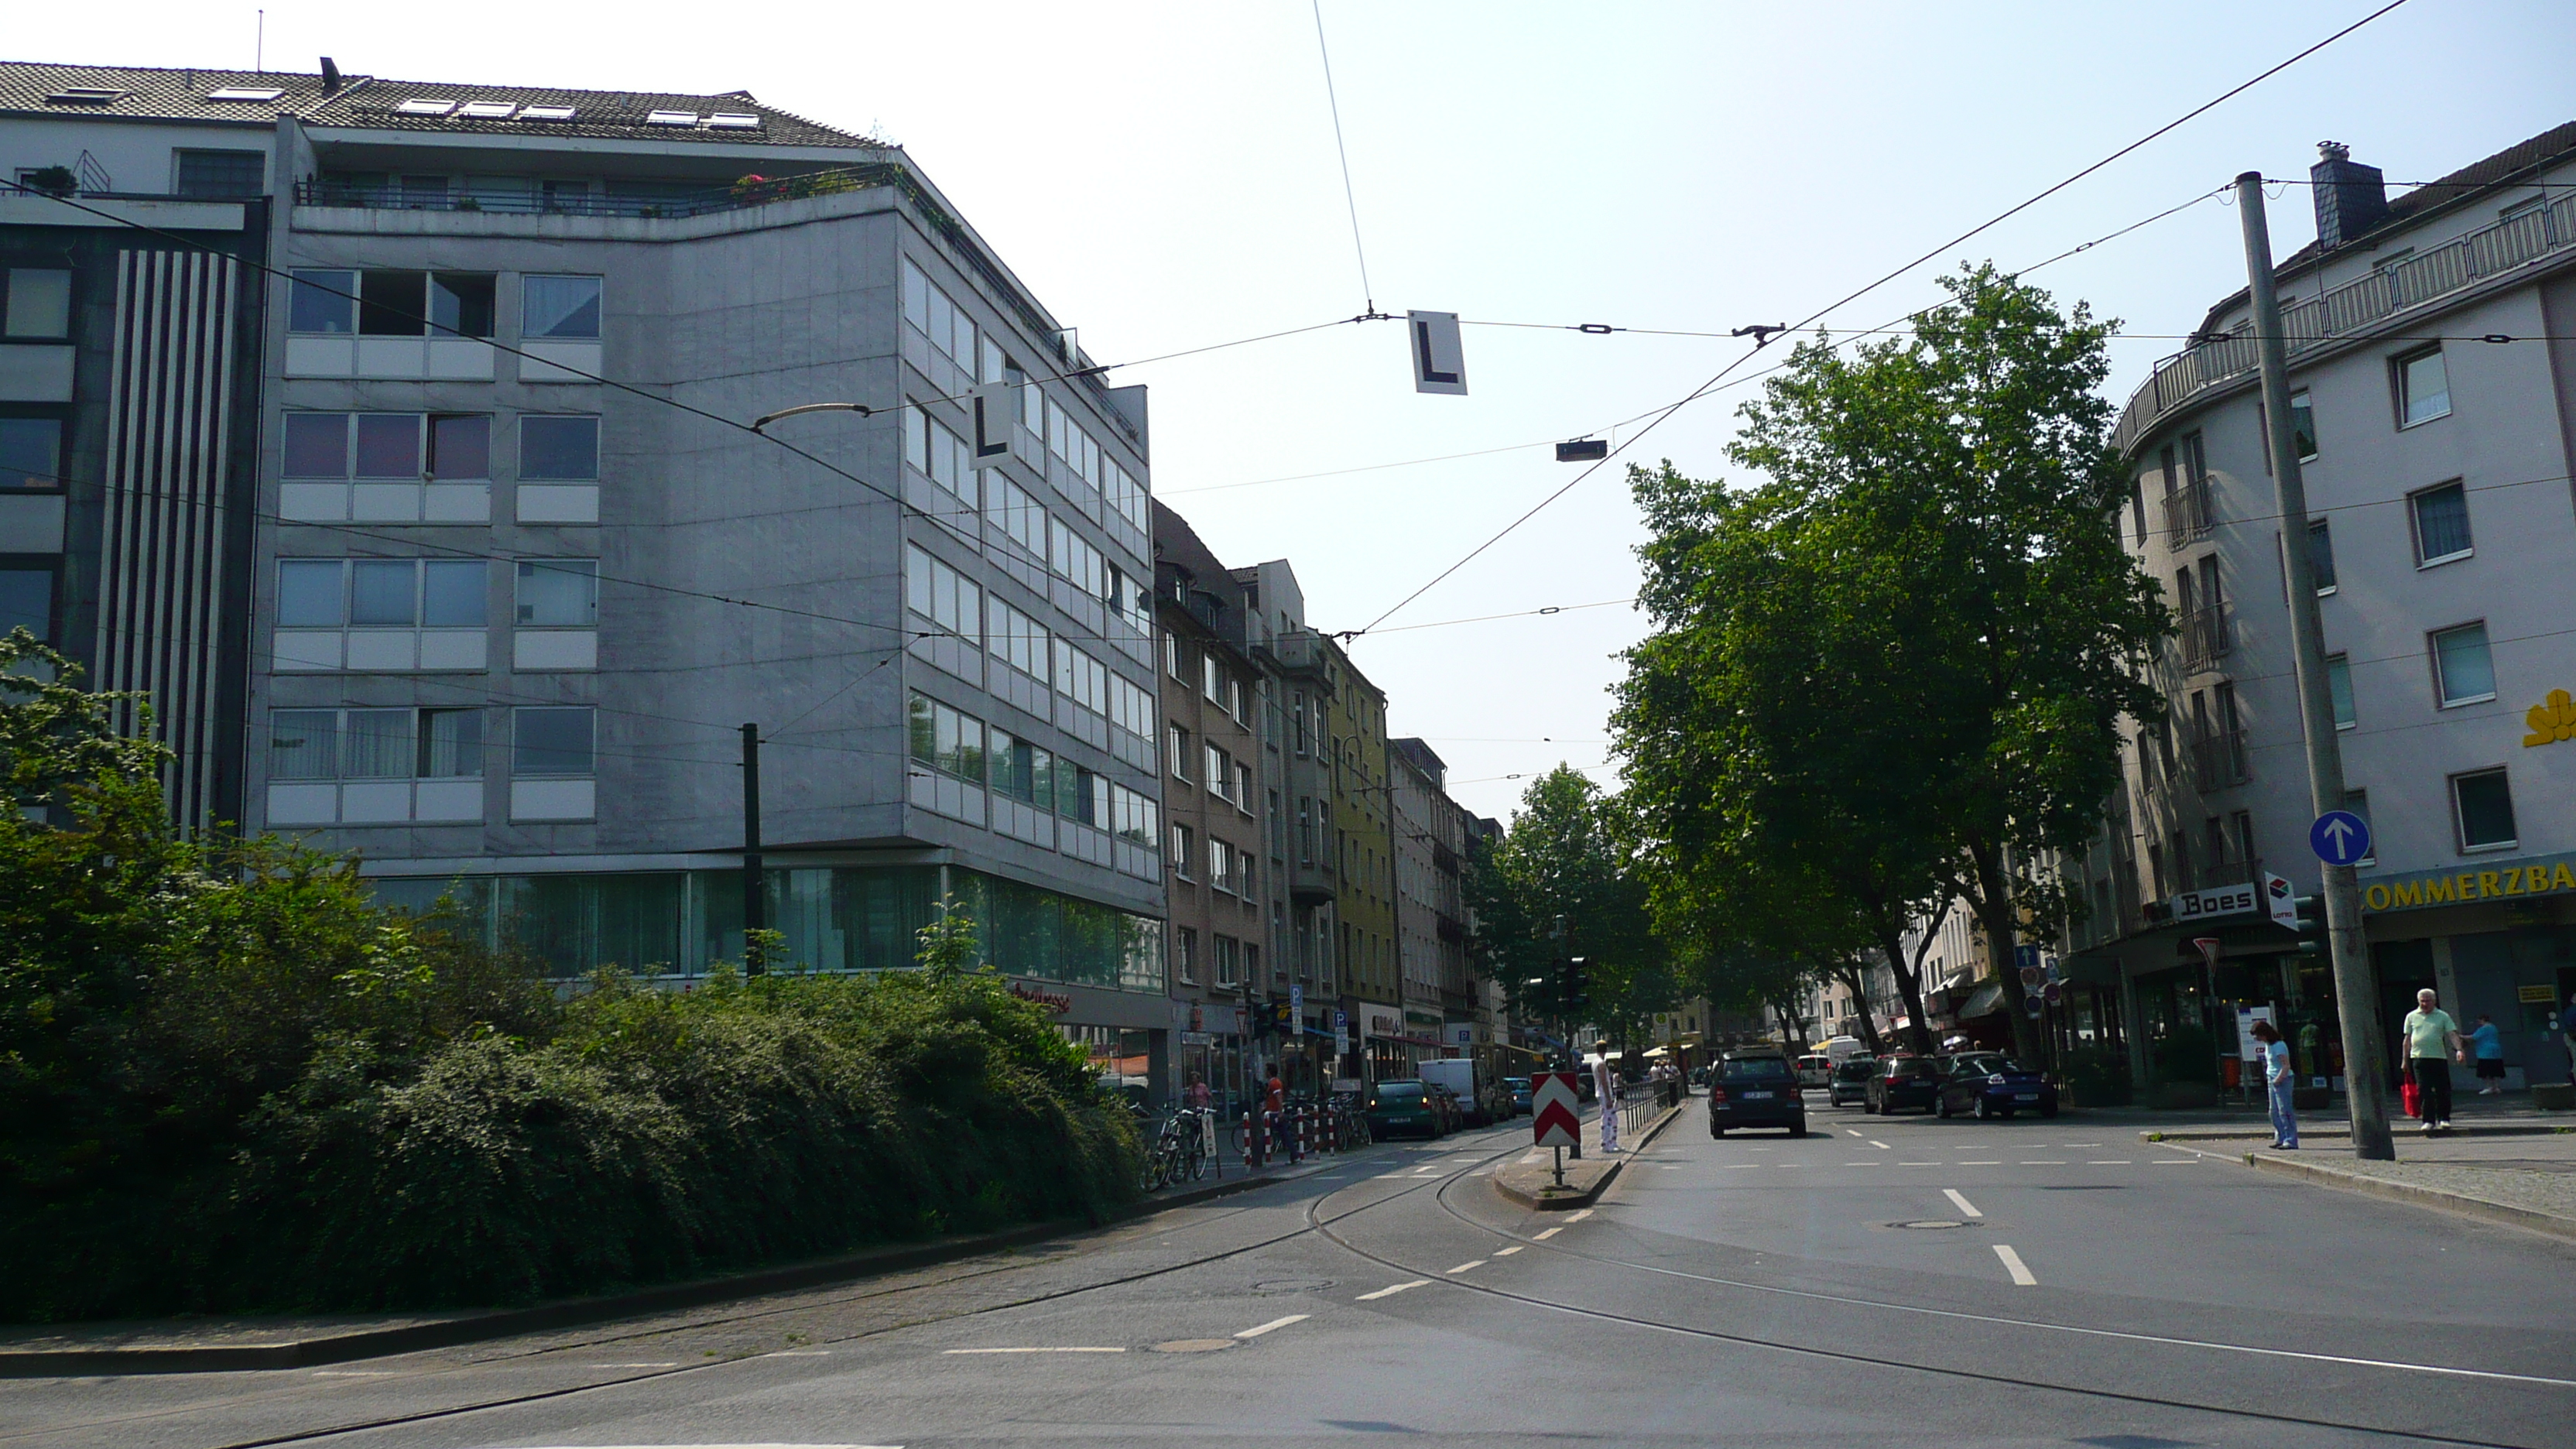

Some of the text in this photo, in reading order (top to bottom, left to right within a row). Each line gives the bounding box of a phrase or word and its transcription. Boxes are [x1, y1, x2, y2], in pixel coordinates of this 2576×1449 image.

[1416, 321, 1458, 383] L
[974, 396, 1007, 457] L
[2181, 892, 2251, 916] Boes
[2358, 862, 2576, 911] OMMERZBA
[1292, 988, 1300, 1004] P
[1337, 1013, 1345, 1026] P
